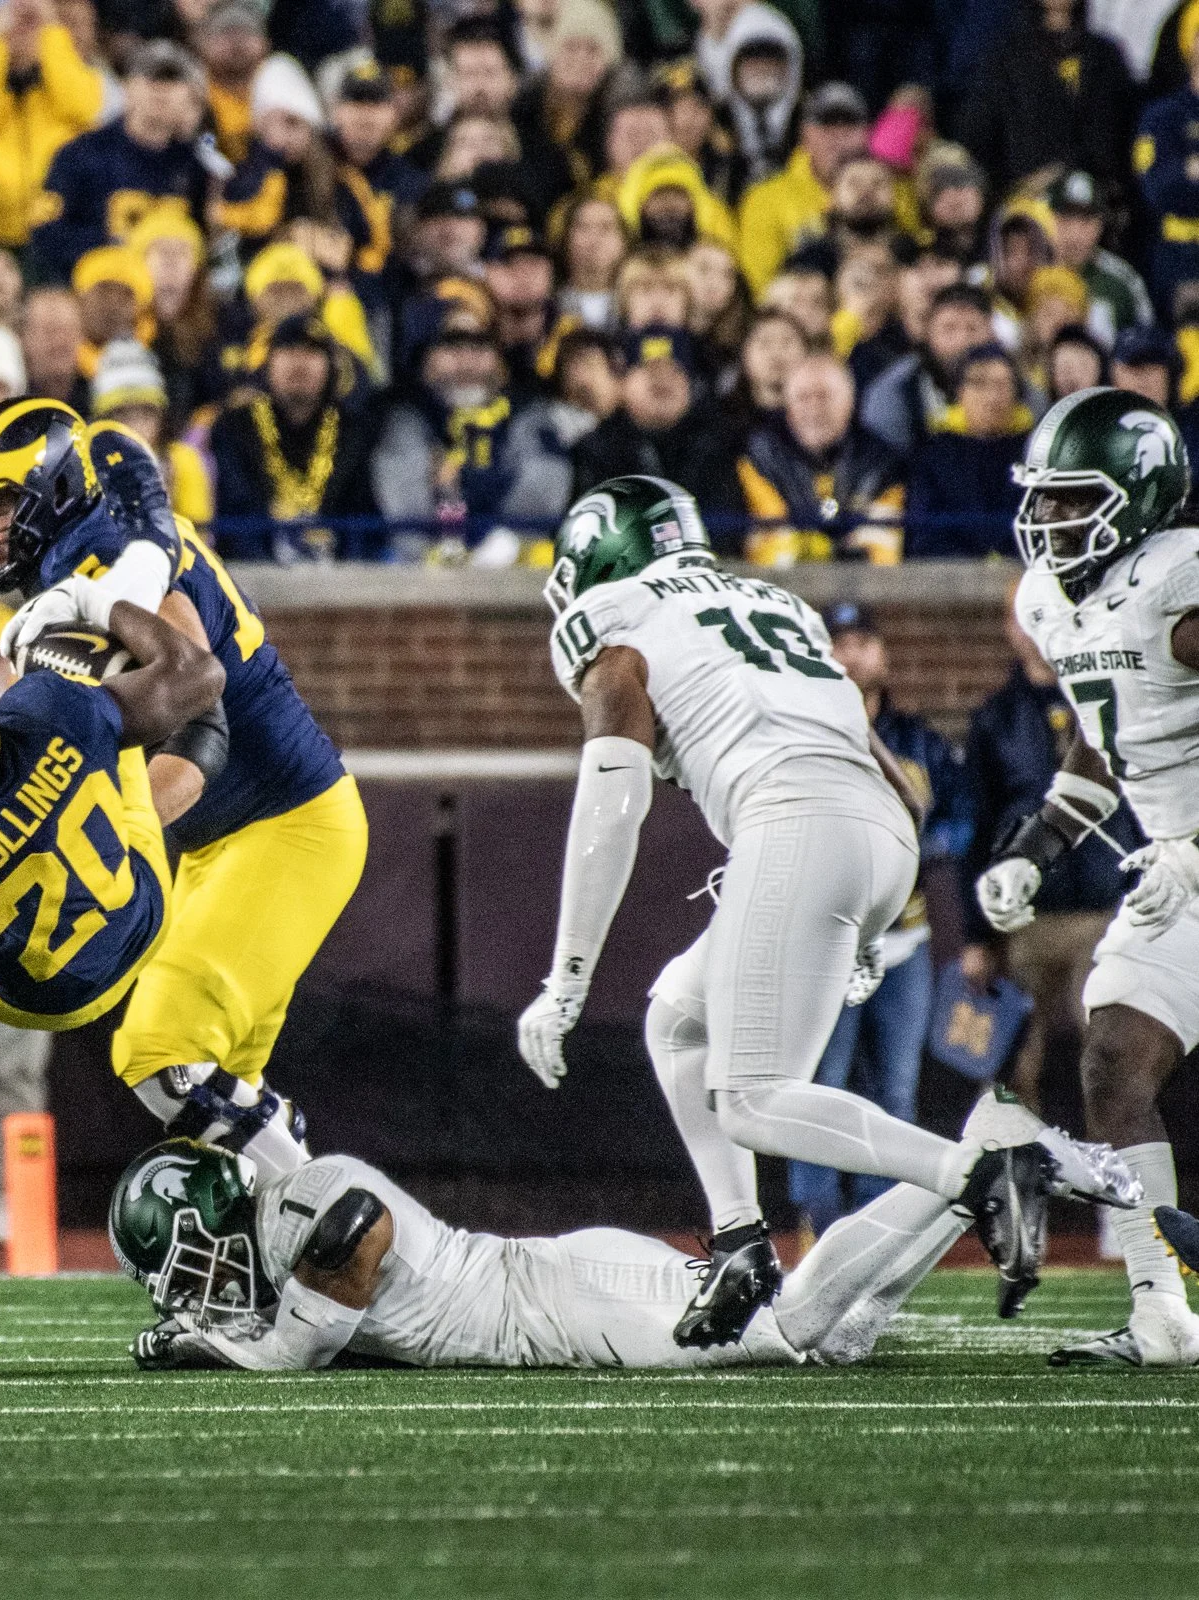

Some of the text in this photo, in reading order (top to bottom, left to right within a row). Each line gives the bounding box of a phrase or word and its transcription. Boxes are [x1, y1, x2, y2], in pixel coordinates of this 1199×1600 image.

[556, 610, 598, 667] 10
[694, 606, 843, 681] 10
[1100, 650, 1147, 671] STATE
[1070, 678, 1127, 781] 7
[279, 1198, 318, 1220] 1
